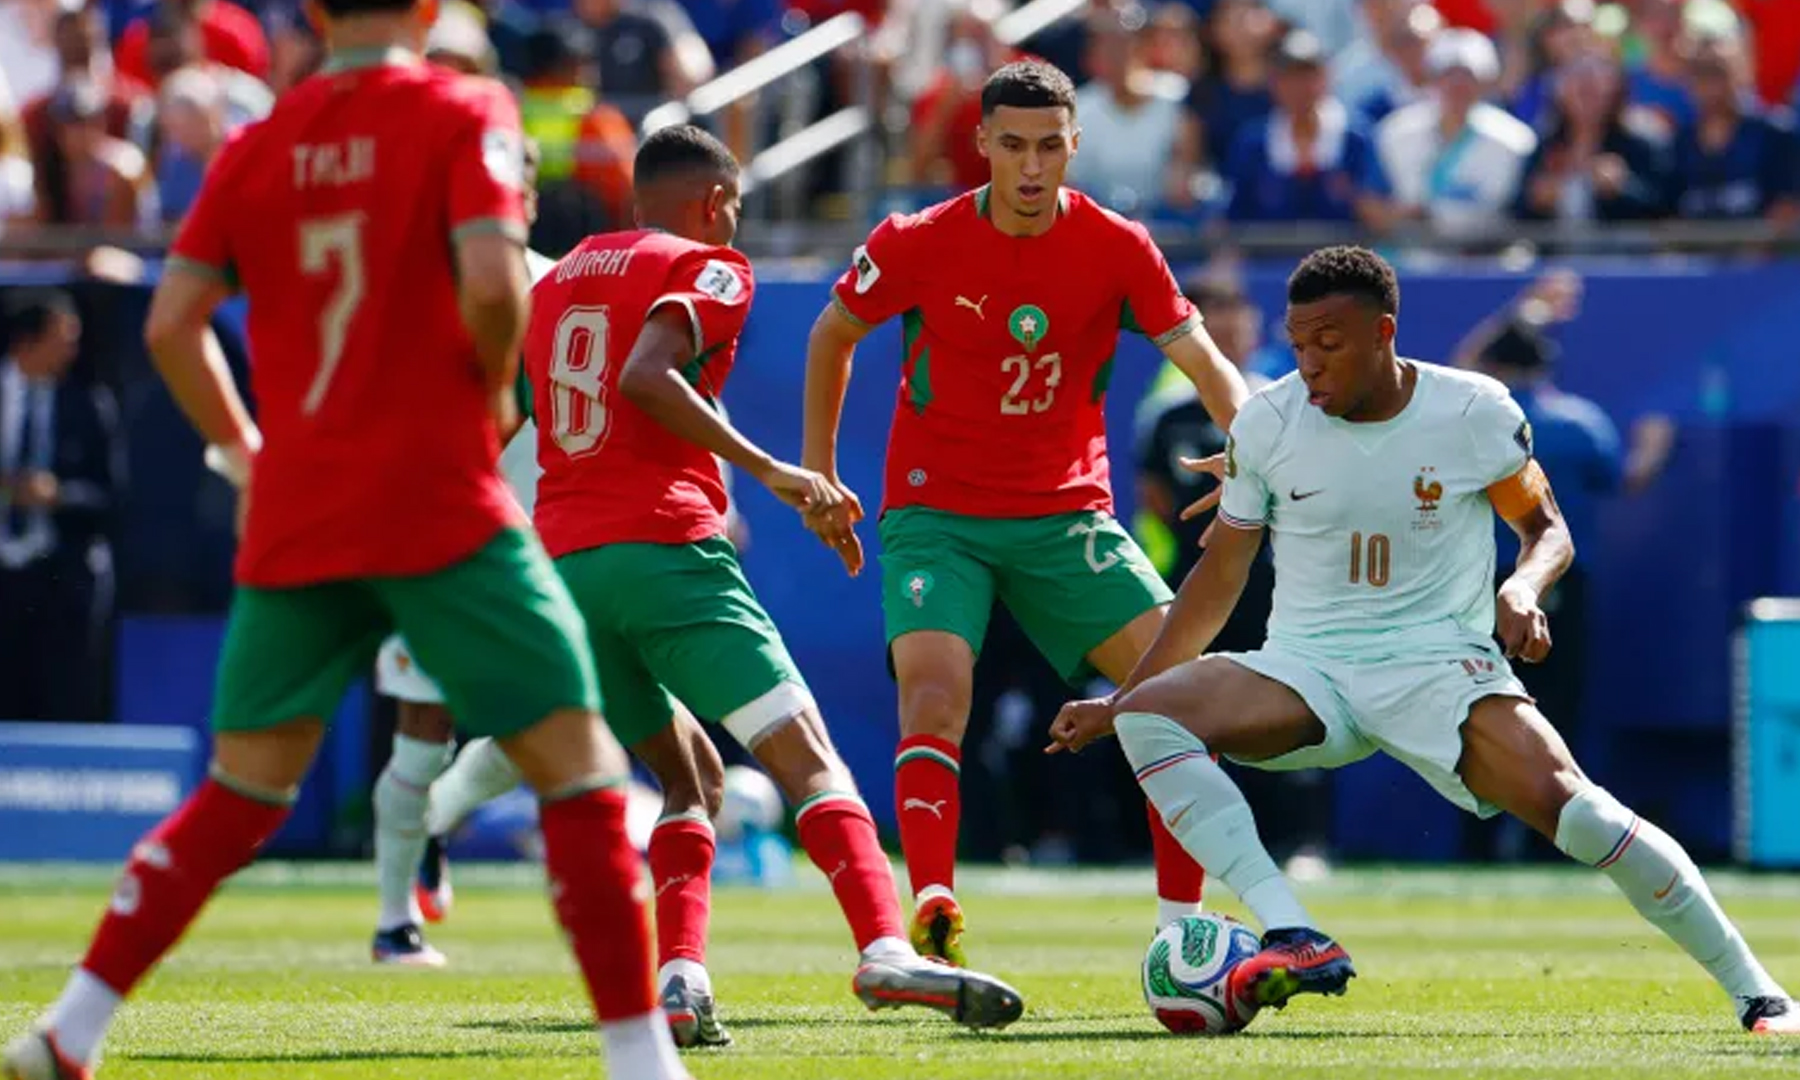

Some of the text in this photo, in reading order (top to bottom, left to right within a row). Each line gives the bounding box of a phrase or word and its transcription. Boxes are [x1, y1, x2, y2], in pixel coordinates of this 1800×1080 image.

[299, 212, 367, 414] 7
[550, 304, 611, 460] 8
[1001, 352, 1061, 415] 23
[1350, 531, 1390, 587] 10
